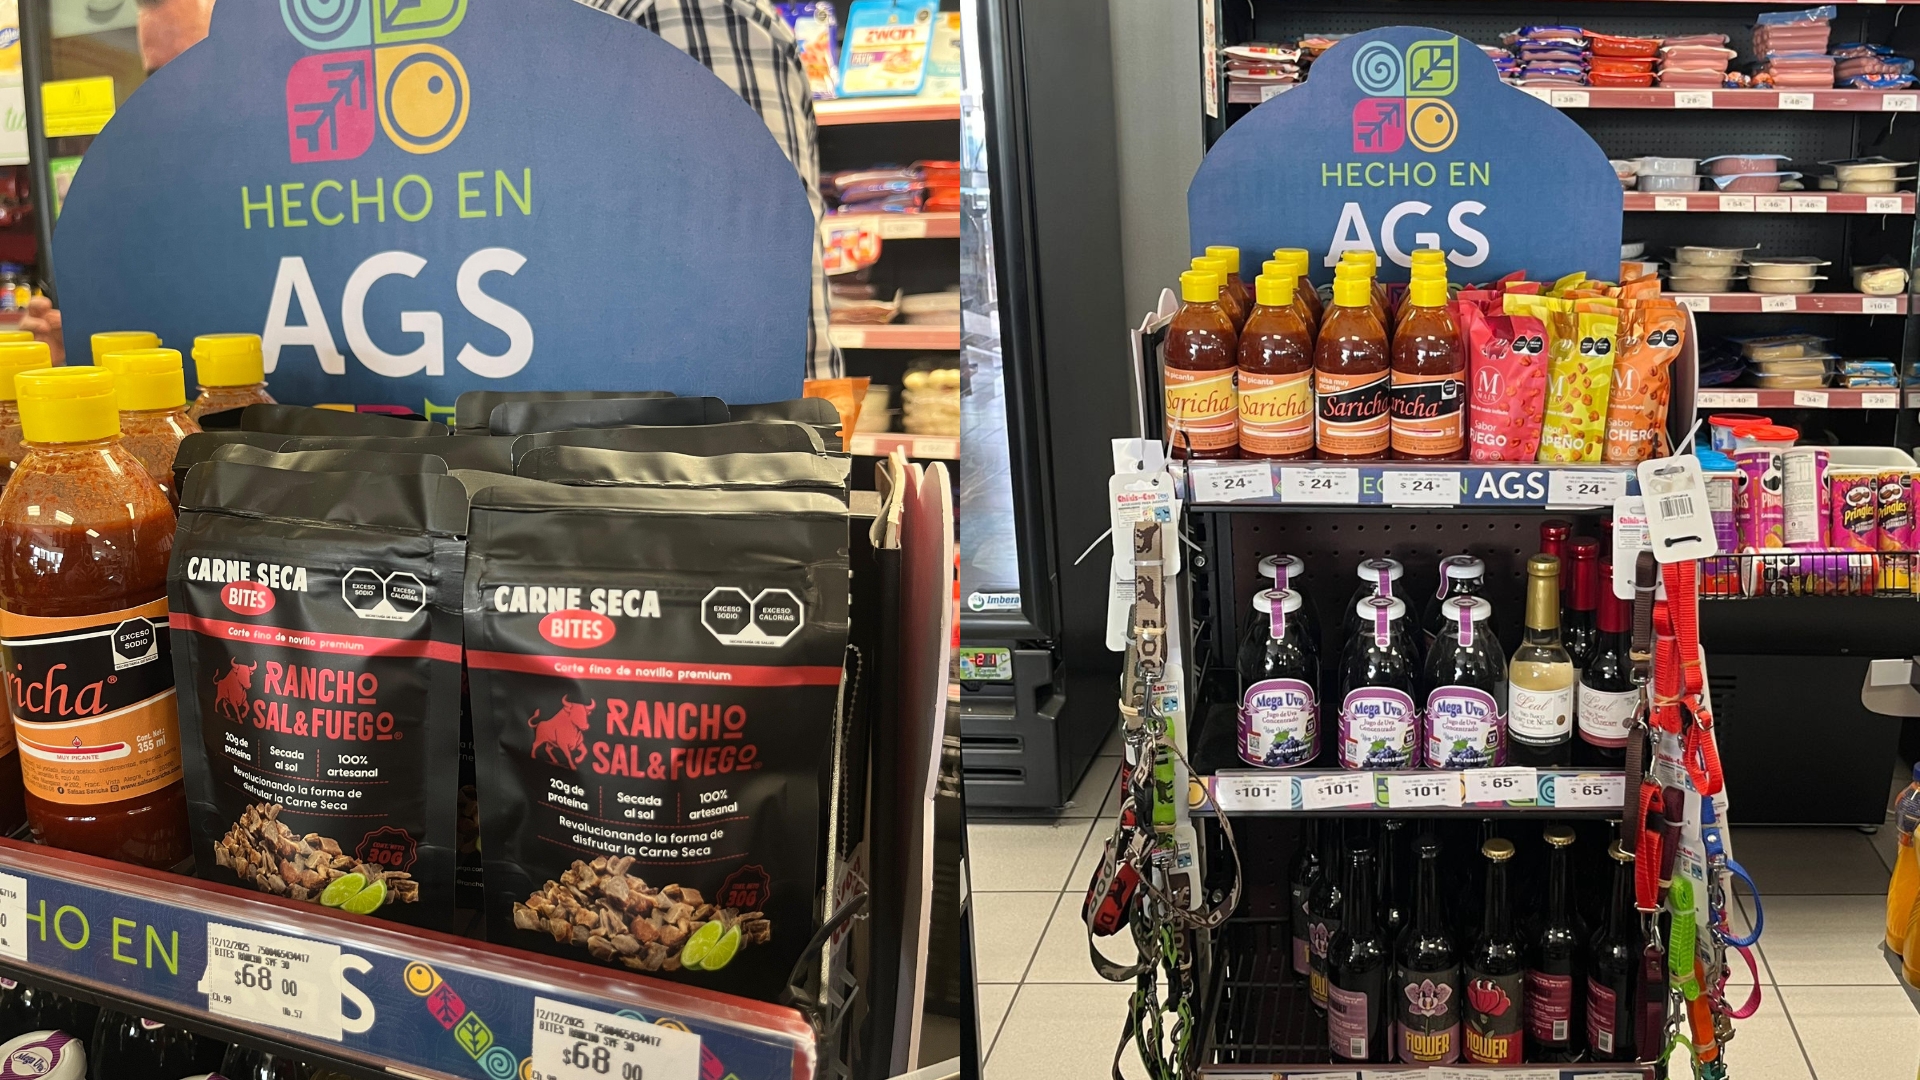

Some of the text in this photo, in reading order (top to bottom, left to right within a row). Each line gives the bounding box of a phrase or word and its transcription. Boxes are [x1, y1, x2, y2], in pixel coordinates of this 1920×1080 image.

[1322, 162, 1490, 187] HECHO EN
[241, 167, 533, 230] HECHO EN
[1323, 200, 1490, 269] AGS
[262, 247, 535, 379] AGS
[1168, 372, 1195, 381] picante
[1247, 377, 1274, 386] picante
[1333, 379, 1349, 388] muy
[1478, 371, 1500, 394] M
[1166, 389, 1230, 413] Saricha
[1240, 393, 1307, 418] Saricha
[1474, 420, 1497, 432] Sabor
[1608, 417, 1633, 428] Sabor
[1223, 477, 1246, 490] 24
[1310, 478, 1332, 489] 24
[1412, 480, 1434, 491] 24
[1474, 471, 1545, 500] AGS
[1578, 483, 1600, 495] 24
[187, 556, 308, 592] CARNE SECA
[228, 586, 267, 610] BITES
[352, 583, 416, 595] EXCESO EXCESO
[390, 592, 419, 602] CALORÍAS
[493, 586, 662, 619] CARNE SECA
[713, 605, 742, 613] EXCESO
[986, 595, 1020, 605] Imbera
[758, 613, 795, 621] CALORÍAS
[120, 628, 150, 642] EXCESO
[550, 618, 604, 640] BITES
[124, 638, 148, 650] SODIO
[228, 627, 364, 651] Corte fino de novillo premium
[553, 661, 732, 682] Corte fino de novillo premium
[263, 660, 379, 705] RANCHO
[1256, 692, 1304, 711] Mega Uva
[1354, 701, 1402, 719] Mega Uva
[1437, 700, 1485, 718] Mega Uva
[1515, 693, 1552, 711] Leal
[1582, 692, 1618, 711] Leal
[252, 699, 395, 741] SAL&FUEGO
[606, 698, 748, 741] RANCHO
[1262, 716, 1299, 724] Concentrado
[1442, 723, 1478, 732] Concentrado
[1446, 717, 1459, 726] Jugo
[137, 735, 166, 754] 355 ml
[224, 731, 249, 748] 20g de
[223, 743, 252, 762] proteína
[269, 745, 305, 760] Secada
[337, 754, 368, 765] 100%
[592, 741, 758, 781] SAL&FUEGO
[274, 760, 298, 772] al sol
[327, 766, 378, 778] artesanal
[233, 765, 363, 799] Revolucionando la forma de
[549, 778, 585, 797] 20g de
[1492, 777, 1514, 788] 65
[1582, 785, 1603, 796] 65
[243, 780, 348, 811] disfrutar la Carne Seca
[547, 791, 589, 811] proteína
[616, 791, 662, 806] Secada
[698, 788, 728, 805] 100%
[623, 807, 655, 820] al sol
[688, 801, 738, 820] artesanal
[559, 815, 724, 844] Revolucionando la forma de
[572, 833, 711, 858] disfrutar la Carne Seca
[367, 849, 403, 866] 30G
[112, 916, 179, 976] EN
[211, 937, 250, 952] 12/12/2025
[214, 947, 235, 959] BITES
[281, 960, 290, 970] 30
[234, 963, 297, 996] $68 00
[211, 992, 232, 1005] Ch.99
[282, 1006, 303, 1019] Ub.57
[535, 1008, 585, 1029] 12/12/2025
[539, 1020, 565, 1035] BITES
[1405, 1031, 1450, 1056] FLOWER
[1466, 1030, 1508, 1059] FLOWER
[15, 1052, 46, 1072] Mega Uva
[562, 1040, 643, 1080] $68 00
